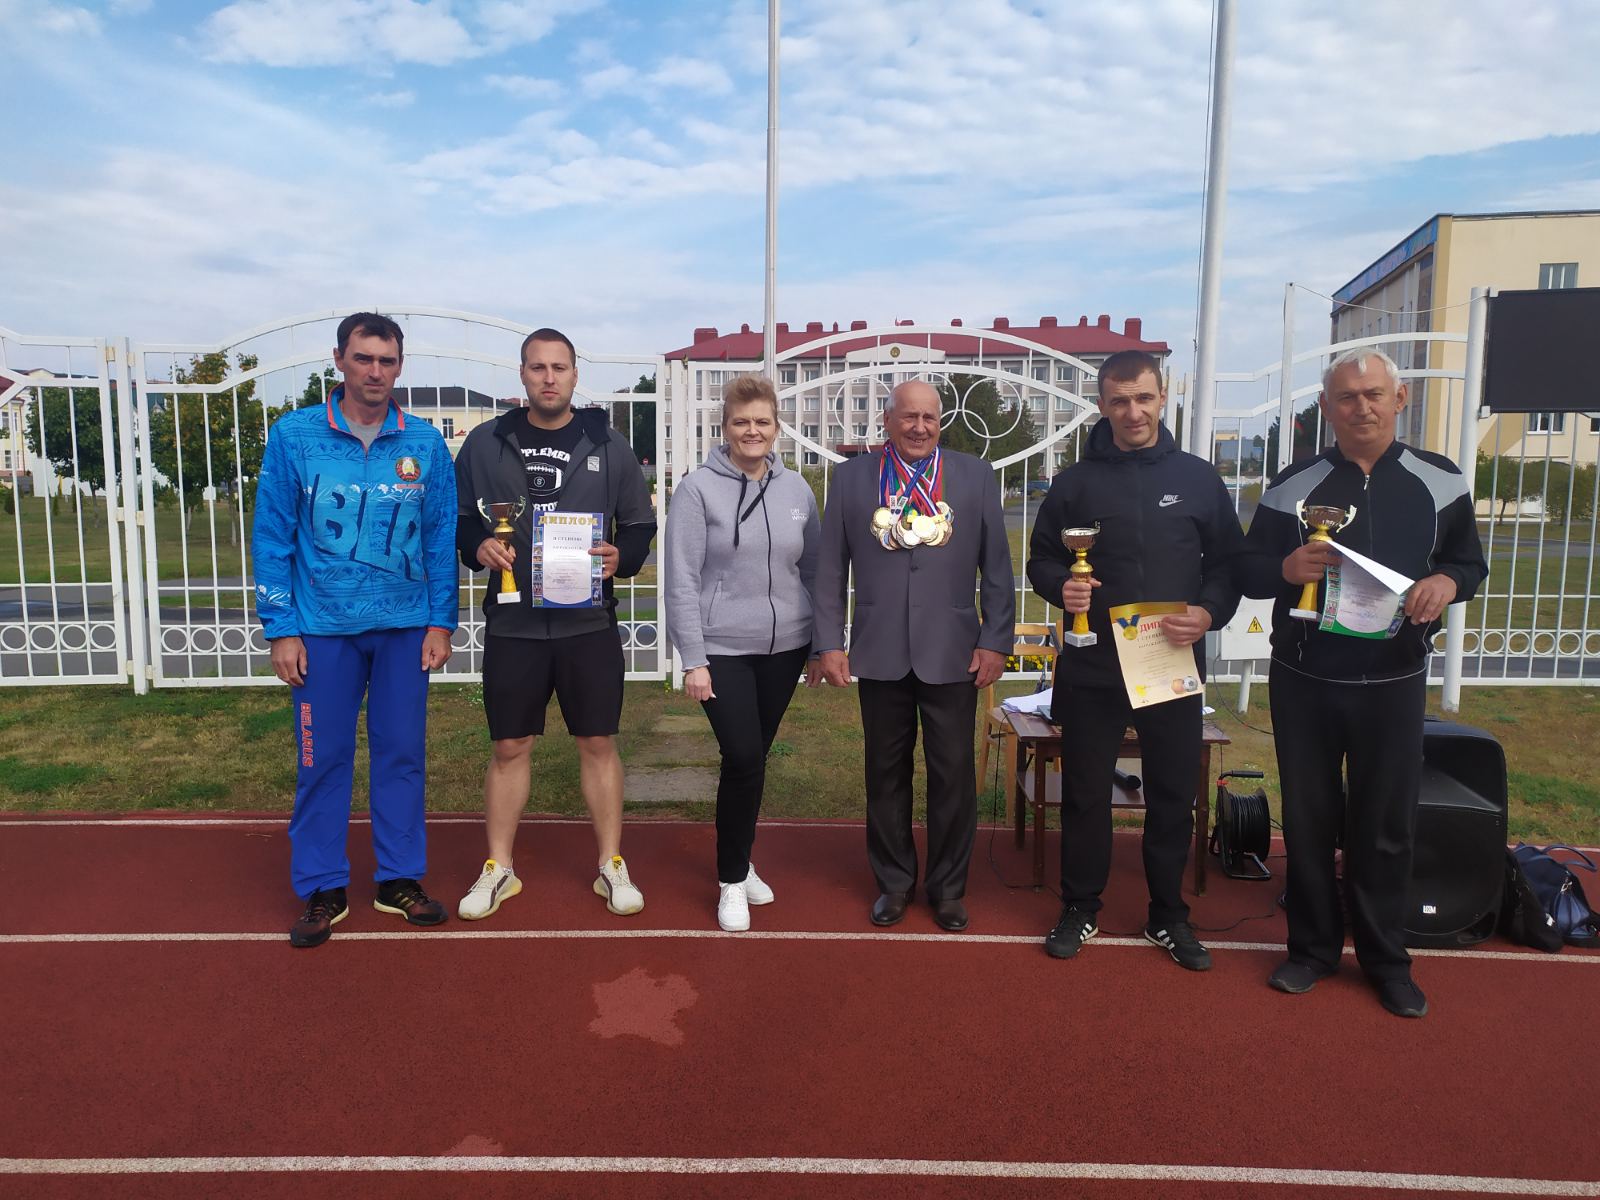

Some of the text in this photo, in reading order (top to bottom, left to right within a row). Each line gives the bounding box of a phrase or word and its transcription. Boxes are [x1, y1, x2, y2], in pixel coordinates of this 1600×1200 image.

[1162, 494, 1180, 502] NIKE
[309, 473, 427, 581] BLR
[538, 515, 599, 526] ДИПЛОМ
[301, 703, 313, 767] BELARUS
